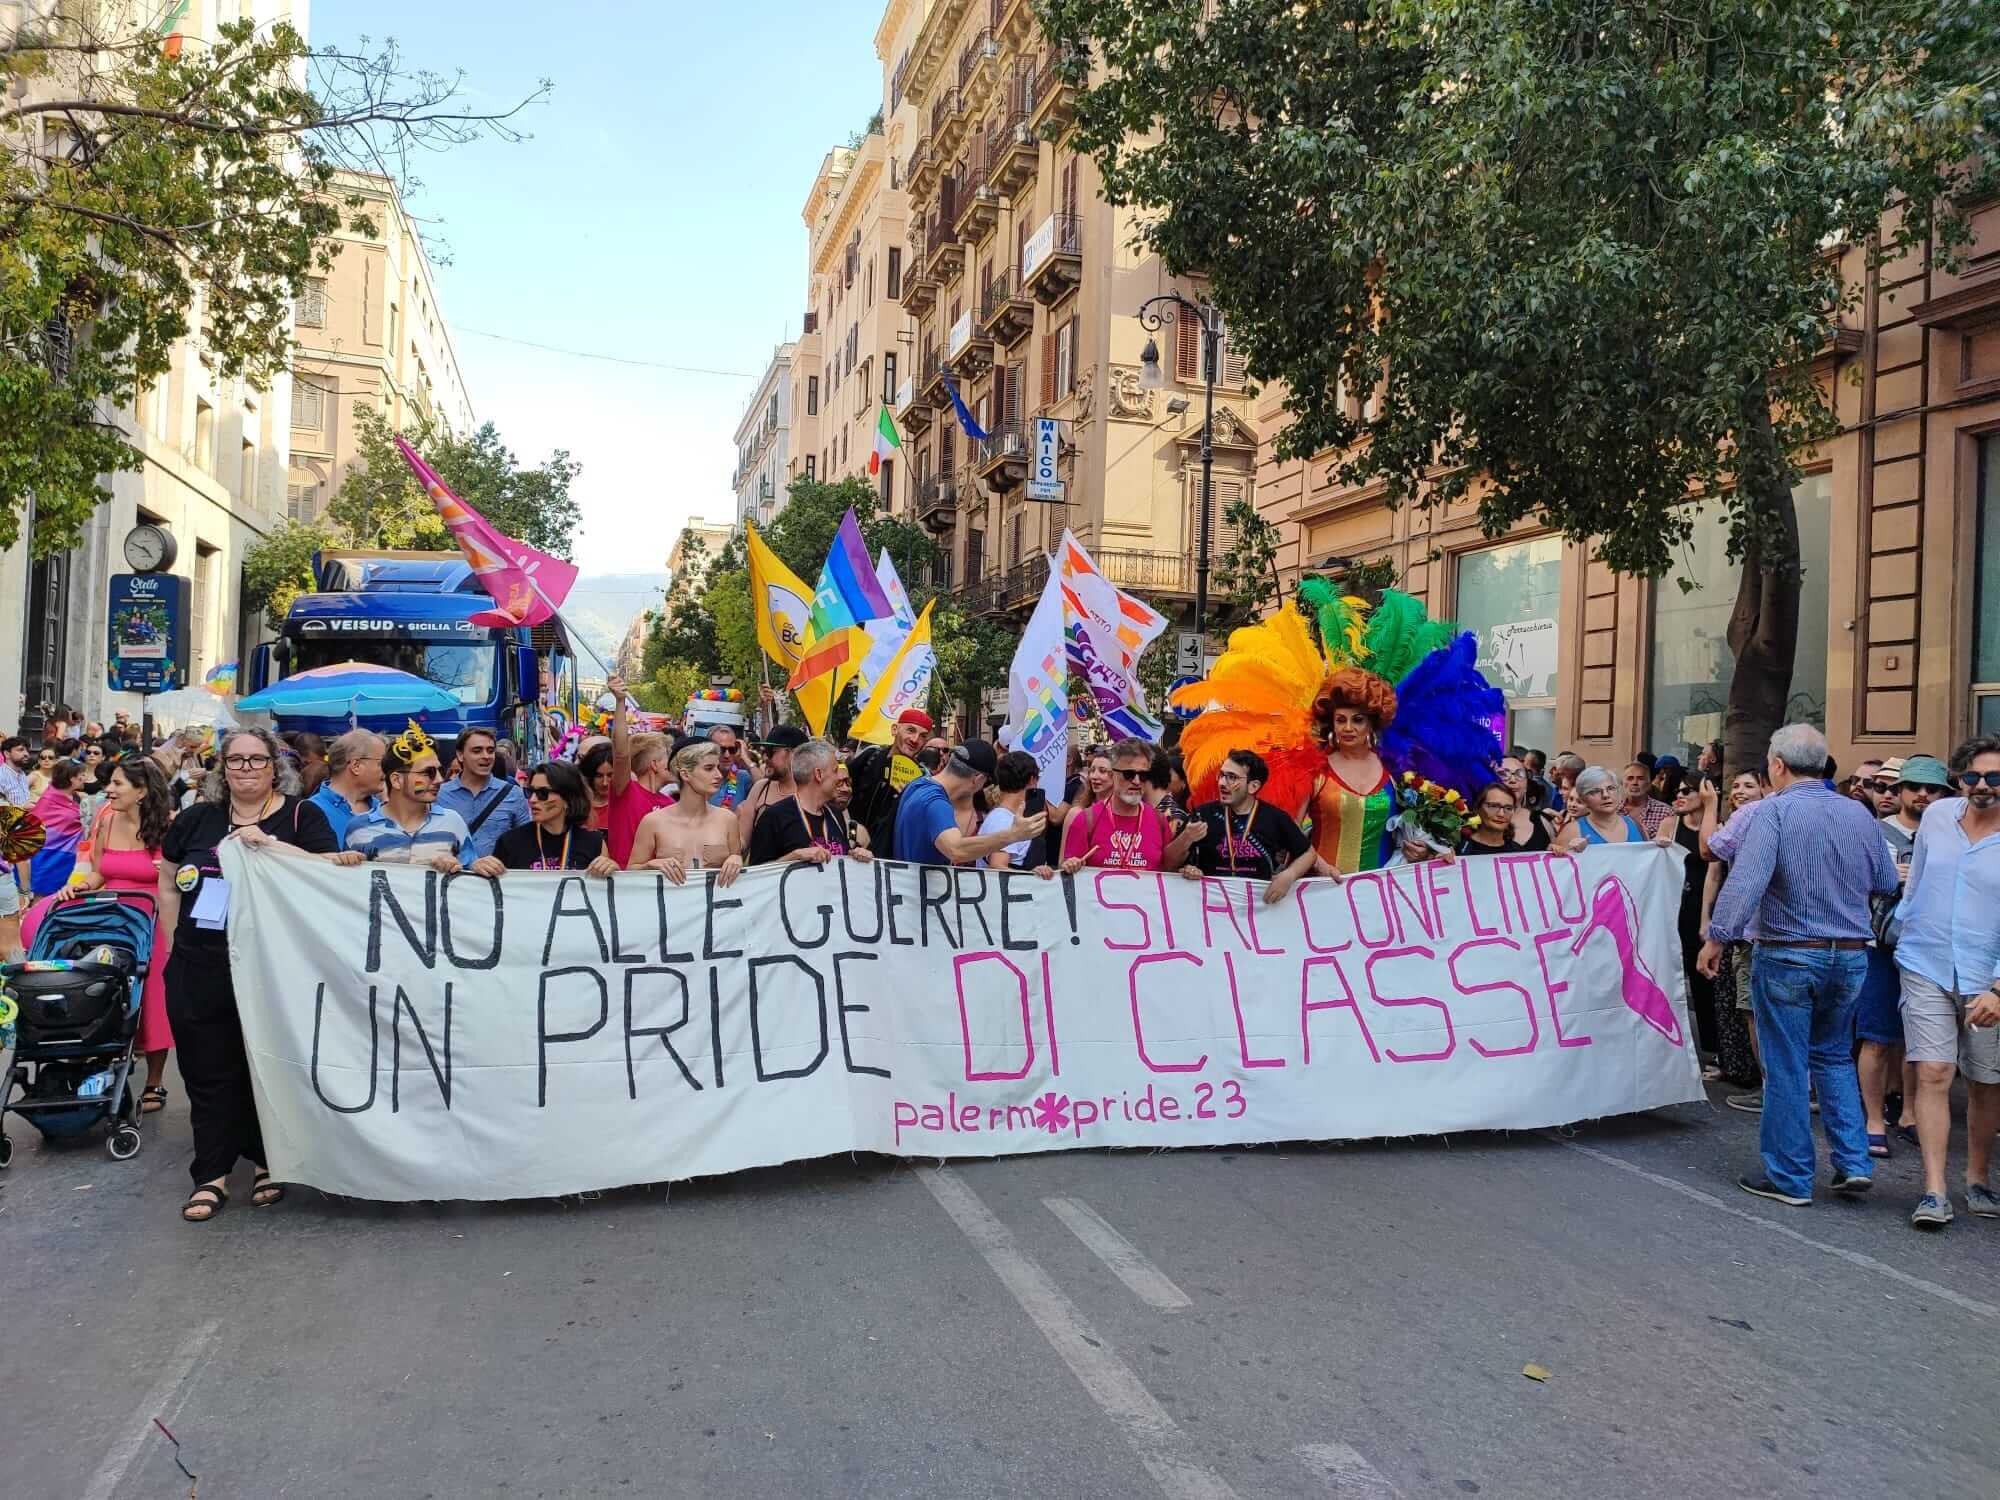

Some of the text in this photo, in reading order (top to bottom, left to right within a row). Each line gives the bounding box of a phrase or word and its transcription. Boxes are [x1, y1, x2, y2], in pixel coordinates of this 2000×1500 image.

[1040, 420, 1054, 478] MAICO
[330, 620, 394, 631] VEISUD
[408, 623, 451, 631] SICILIA
[366, 870, 504, 972] NO
[543, 870, 745, 967] ALLE
[1094, 870, 1174, 953] SI
[1201, 876, 1285, 955] AL
[1300, 852, 1588, 953] CONFLITTO
[310, 928, 1592, 1114] UN PRIDE DI CLASSE
